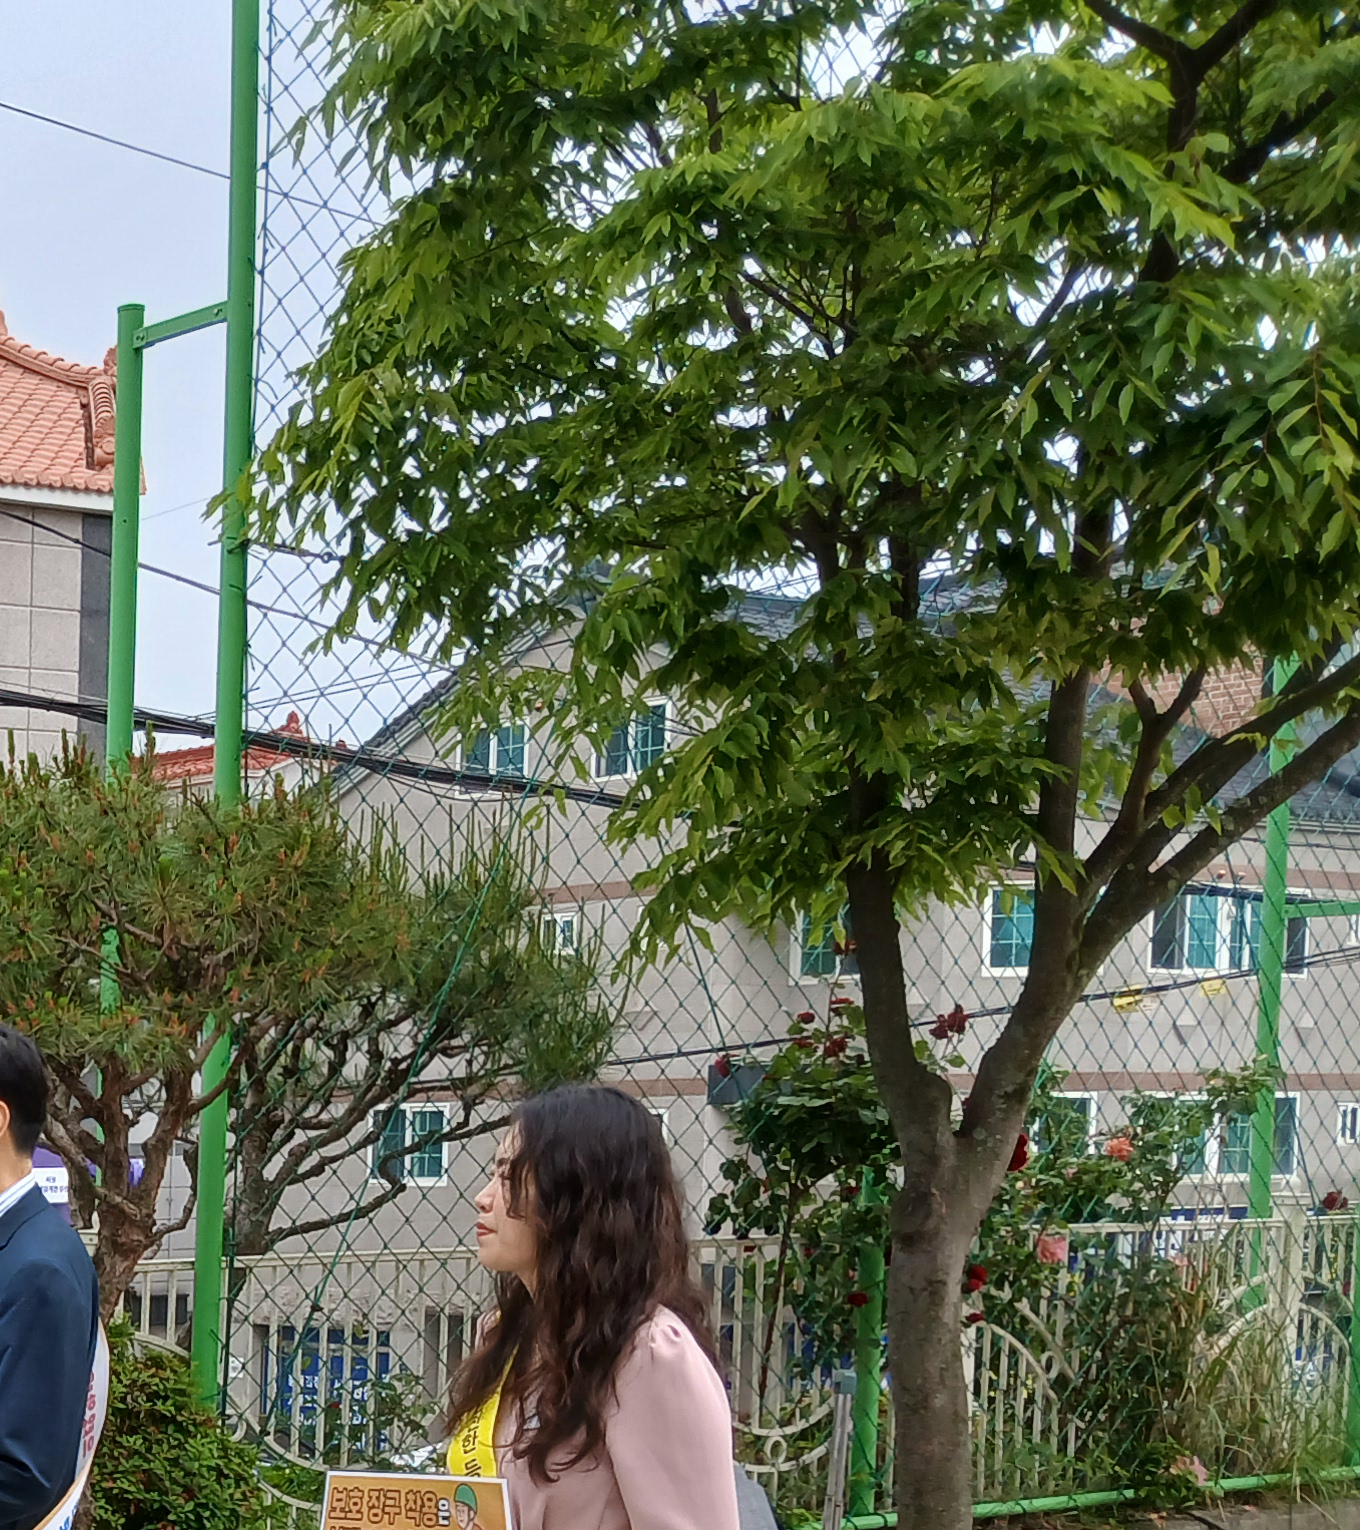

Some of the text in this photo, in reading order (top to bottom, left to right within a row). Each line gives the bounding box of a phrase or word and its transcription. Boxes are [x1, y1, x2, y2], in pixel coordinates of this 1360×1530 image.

[327, 1486, 451, 1529] 보호 장구 착용은
